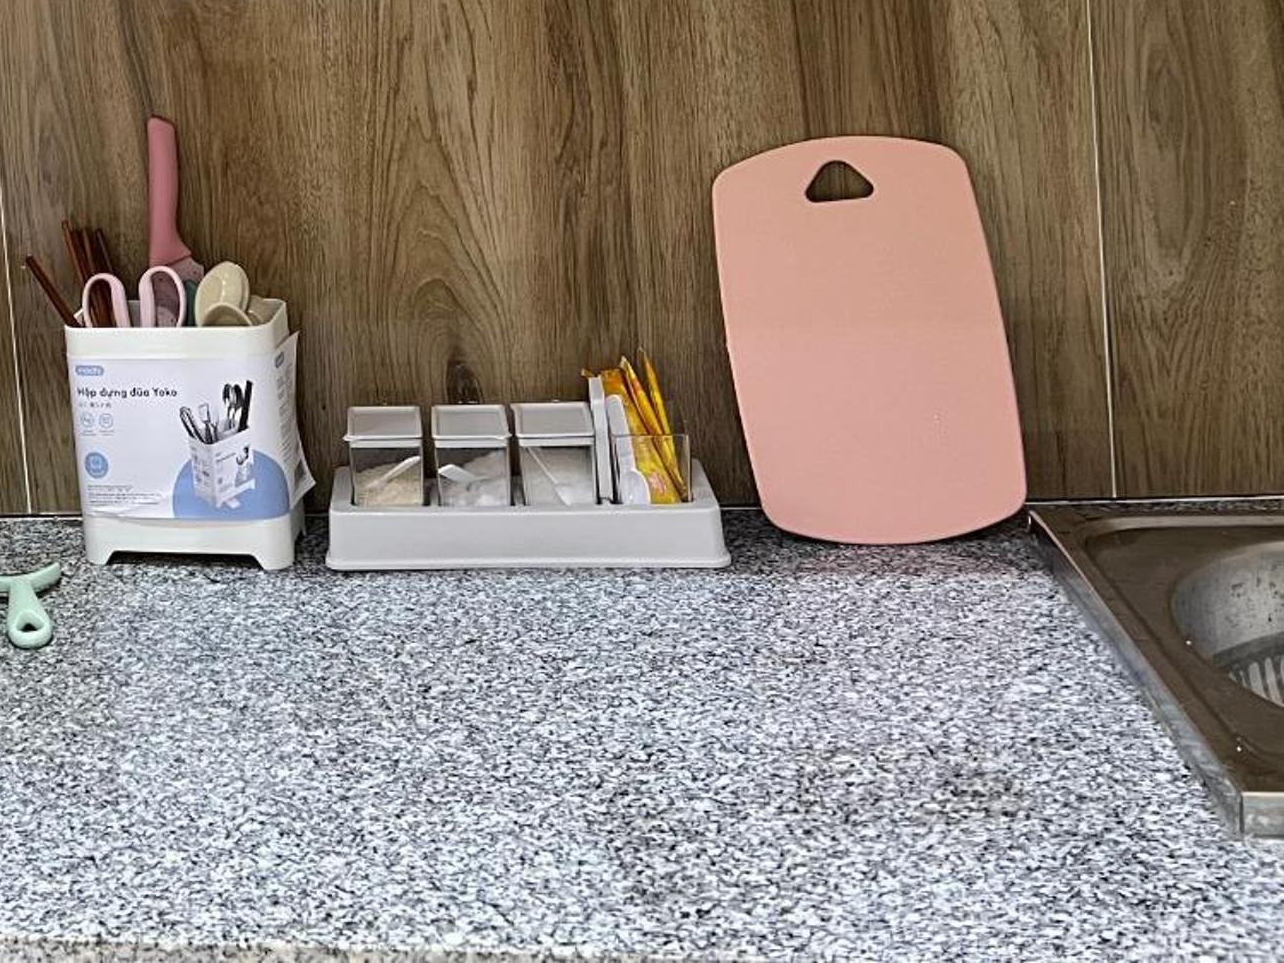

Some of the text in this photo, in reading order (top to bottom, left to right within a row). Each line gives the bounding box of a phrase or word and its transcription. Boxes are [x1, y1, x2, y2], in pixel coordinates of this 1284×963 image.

[77, 387, 97, 398] Hộp
[129, 387, 150, 397] đũa
[152, 387, 178, 397] Yoko
